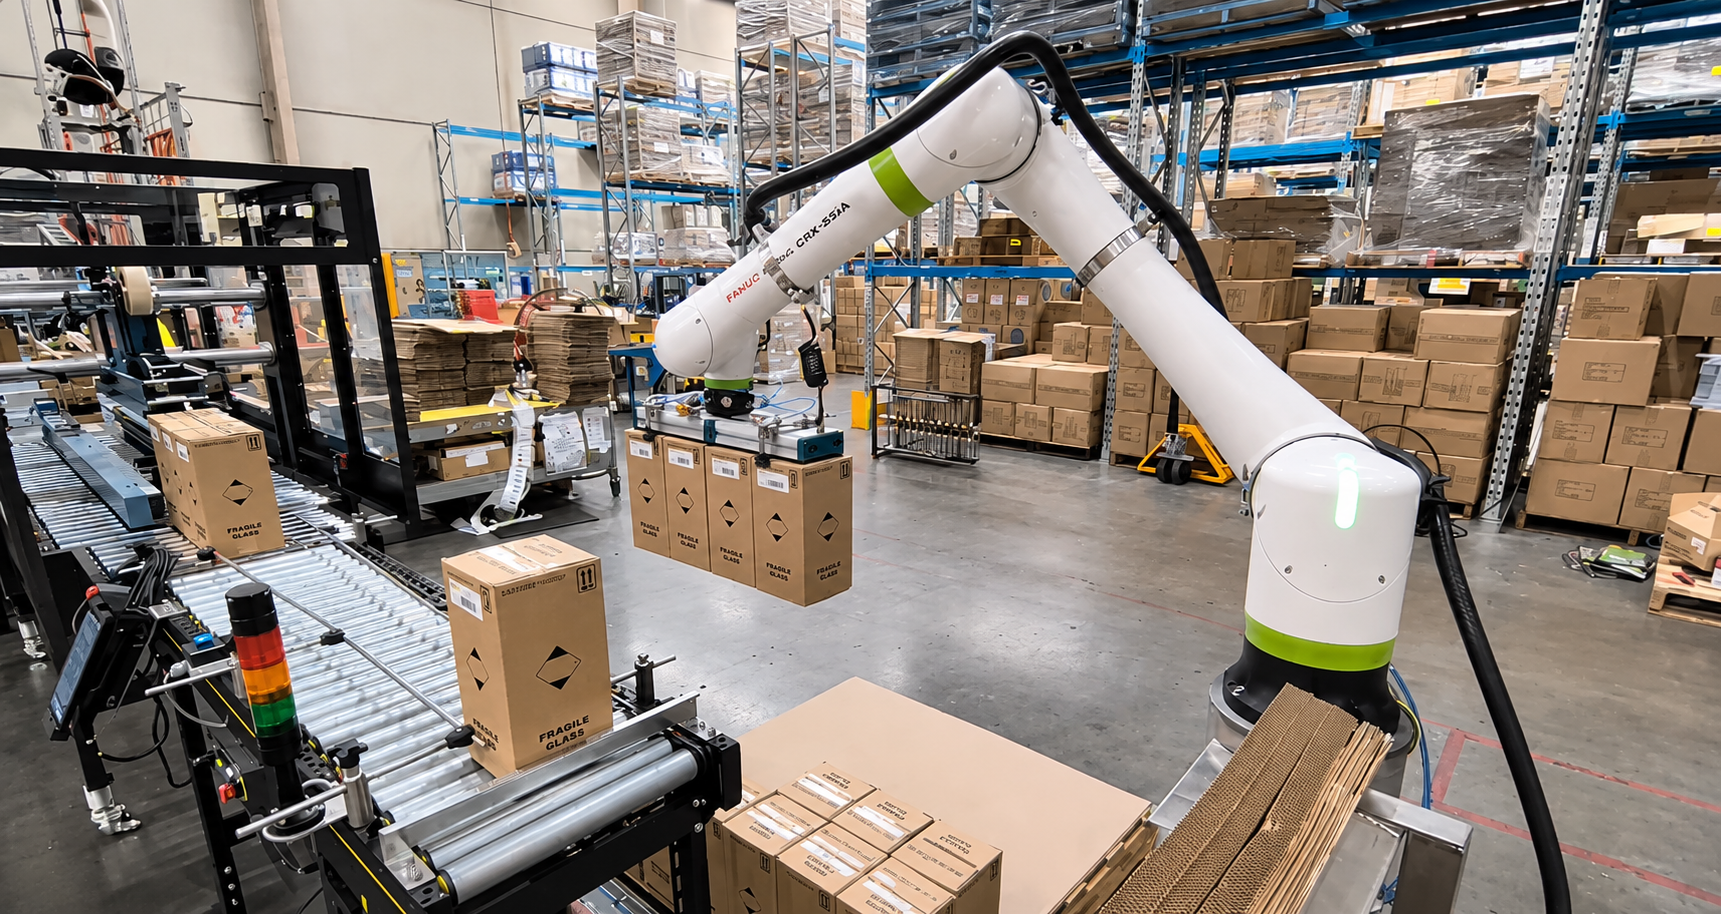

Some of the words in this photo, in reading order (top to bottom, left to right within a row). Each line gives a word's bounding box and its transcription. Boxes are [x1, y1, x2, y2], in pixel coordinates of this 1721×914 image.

[726, 272, 760, 303] FANUC
[227, 522, 262, 534] FRAGILE
[232, 530, 260, 539] GLASS
[539, 715, 589, 743] FRAGILE
[546, 728, 584, 750] GLASS
